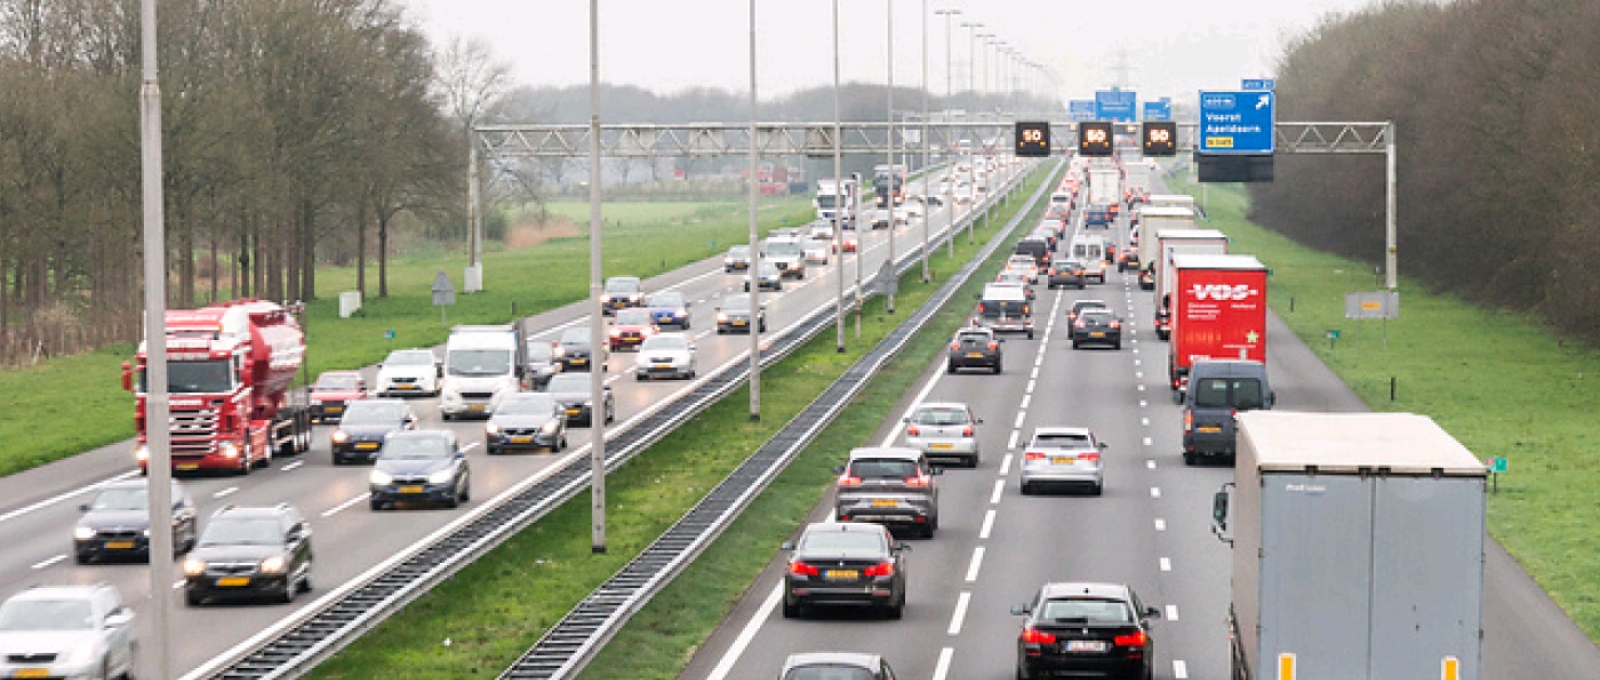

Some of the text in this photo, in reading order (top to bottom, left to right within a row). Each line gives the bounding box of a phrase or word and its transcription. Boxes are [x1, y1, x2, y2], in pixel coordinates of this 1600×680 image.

[1023, 130, 1042, 142] 50
[1086, 130, 1106, 142] 50
[1150, 130, 1169, 142] 50
